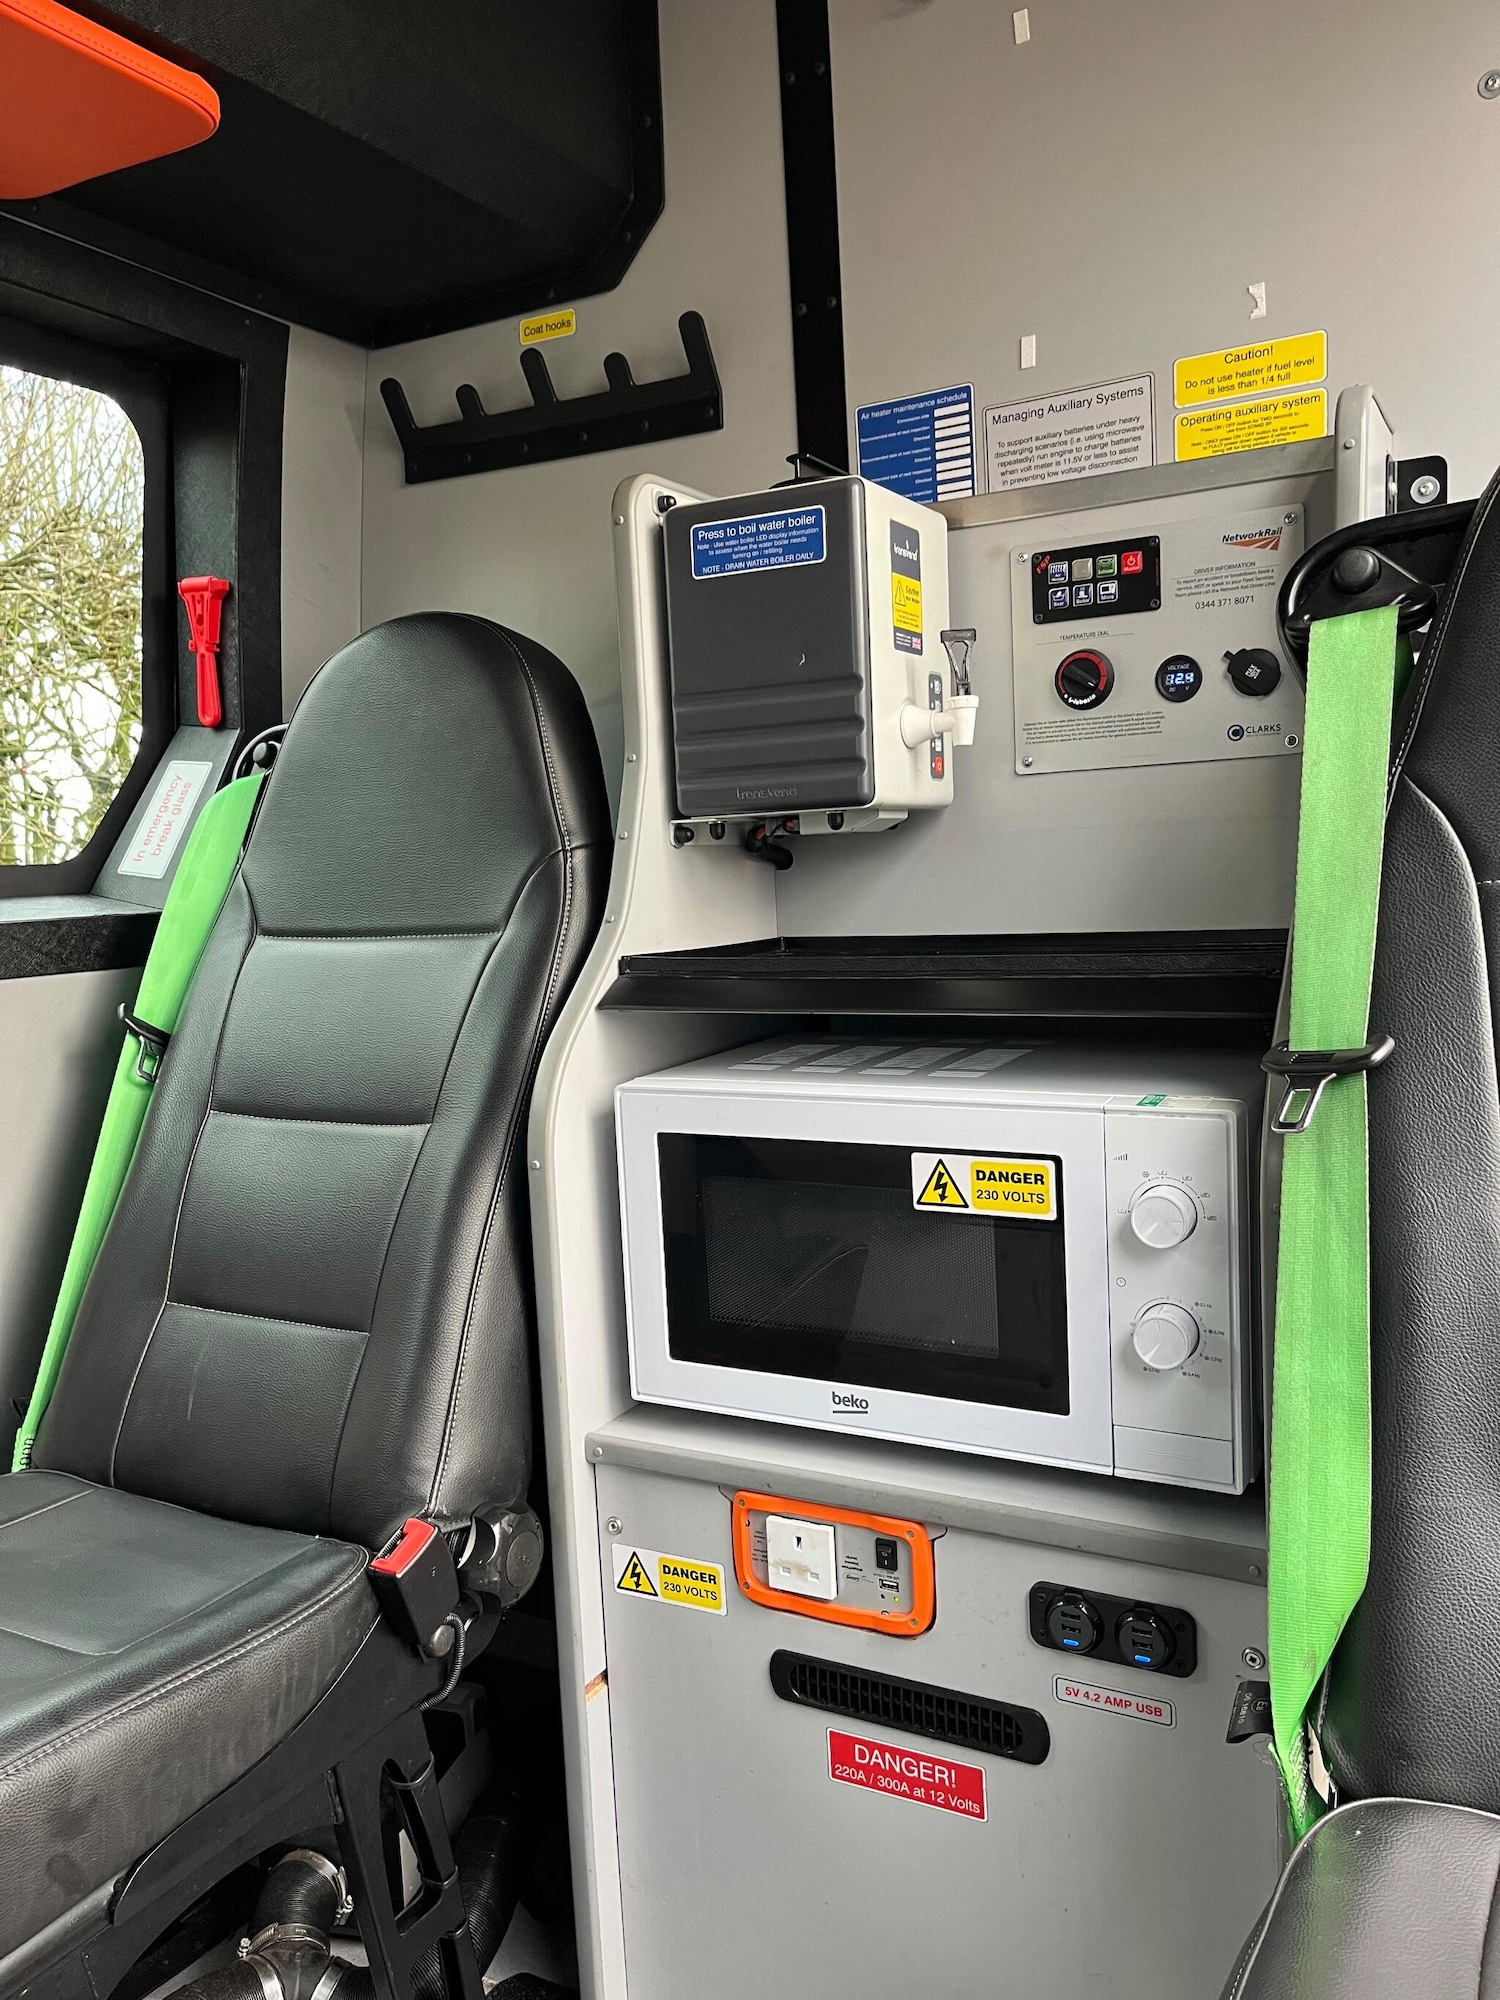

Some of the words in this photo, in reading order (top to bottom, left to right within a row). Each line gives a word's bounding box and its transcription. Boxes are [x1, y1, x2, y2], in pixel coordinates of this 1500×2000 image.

[524, 325, 543, 336] Coat
[546, 319, 571, 331] hooks
[1225, 345, 1274, 364] Caution!
[1185, 380, 1197, 389] Do
[1200, 377, 1214, 387] not
[1217, 374, 1233, 383] use
[1235, 367, 1263, 379] heater
[1267, 365, 1272, 373] if
[1274, 361, 1291, 371] fuel
[1294, 357, 1315, 368] level
[1208, 387, 1215, 395] is
[1218, 383, 1235, 392] less
[1238, 378, 1257, 389] than
[1261, 376, 1274, 385] 1/4
[1277, 372, 1291, 380] full
[871, 409, 891, 417] heater
[893, 400, 935, 414] maintenance
[937, 392, 968, 404] schedule
[992, 407, 1044, 425] Managing
[1047, 397, 1093, 415] Auxiliary
[1096, 386, 1144, 404] Systems
[1180, 409, 1232, 427] Operating
[1235, 402, 1279, 417] auxiliary
[1282, 395, 1321, 409] system
[994, 446, 1033, 459] discharging
[1035, 440, 1068, 451] scenarios
[1085, 433, 1104, 442] using
[1106, 424, 1145, 437] microwave
[1006, 436, 1033, 447] support
[1035, 430, 1063, 442] auxiliary
[1064, 425, 1094, 436] batteries
[1096, 420, 1117, 429] under
[1119, 415, 1141, 425] heavy
[997, 455, 1035, 468] repeatedly)
[1037, 452, 1048, 460] run
[1050, 447, 1074, 458] engine
[1084, 441, 1109, 452] charge
[1111, 434, 1142, 446] batteries
[1001, 467, 1019, 476] when
[1020, 464, 1032, 473] volt
[1034, 461, 1053, 470] meter
[1063, 455, 1083, 465] 11.5V
[1093, 450, 1108, 459] less
[1119, 445, 1139, 455] assist
[1002, 478, 1008, 486] in
[1010, 471, 1046, 486] preventing
[1047, 469, 1059, 477] low
[1061, 464, 1086, 475] voltage
[1088, 455, 1138, 470] disconnection
[698, 529, 724, 541] Press
[726, 527, 736, 536] to
[739, 523, 756, 535] boil
[759, 520, 785, 531] water
[788, 515, 816, 527] boiler
[768, 531, 788, 540] display
[789, 528, 819, 537] information
[1222, 527, 1283, 543] NetworkRail
[703, 566, 720, 574] NOTE
[725, 562, 745, 571] DRAIN
[746, 559, 769, 568] WATER
[770, 554, 794, 564] BOILER
[796, 552, 814, 561] DAILY
[1215, 561, 1256, 572] INFORMATION
[1195, 600, 1215, 609] 0344
[1218, 598, 1231, 607] 371
[1234, 595, 1254, 605] 8071
[1059, 631, 1096, 641] TEMPERATURE
[1246, 724, 1281, 733] CLARKS
[133, 850, 146, 861] In
[143, 775, 183, 846] emergency
[151, 820, 175, 857] break
[172, 782, 192, 816] glass
[975, 1168, 1045, 1185] DANGER
[976, 1189, 999, 1201] 230
[1002, 1190, 1045, 1204] VOLTS
[832, 1391, 869, 1409] beko
[663, 1565, 717, 1585] DANGER
[664, 1582, 681, 1592] 230
[684, 1585, 717, 1601] VOLTS
[1065, 1687, 1080, 1697] 5V
[1083, 1691, 1100, 1702] 4.2
[1104, 1696, 1132, 1709] AMP
[1136, 1702, 1163, 1717] USB
[854, 1744, 956, 1788] DANGER!
[834, 1764, 867, 1782] 220A
[870, 1773, 874, 1785] /
[877, 1775, 910, 1794] 300A
[913, 1786, 925, 1798] at
[929, 1790, 945, 1804] 12
[949, 1794, 981, 1813] Volts
